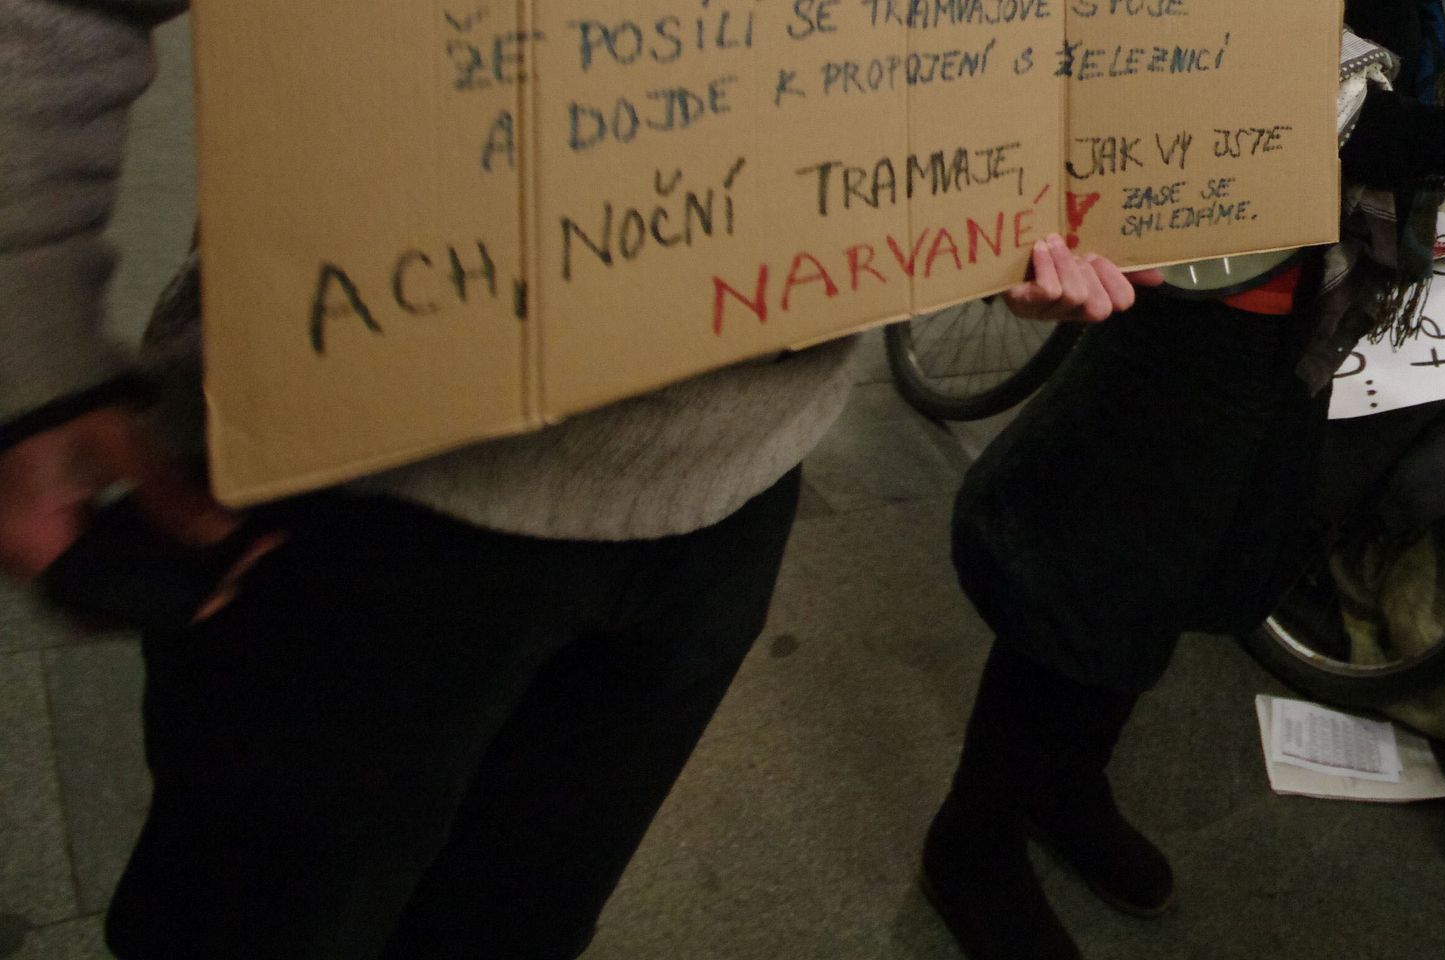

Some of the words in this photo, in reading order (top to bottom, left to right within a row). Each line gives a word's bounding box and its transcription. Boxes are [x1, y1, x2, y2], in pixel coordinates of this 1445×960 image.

[444, 6, 545, 91] ŽE
[481, 109, 515, 173] A
[567, 73, 739, 152] DOJDE
[773, 67, 806, 108] K
[822, 37, 996, 96] PROPOJENÍ
[309, 240, 528, 357] ACH,
[560, 155, 747, 282] NOČNÍ
[1064, 136, 1144, 180] JAK
[1156, 130, 1192, 170] VY
[1213, 124, 1293, 159] JSTE
[1200, 176, 1236, 200] SE
